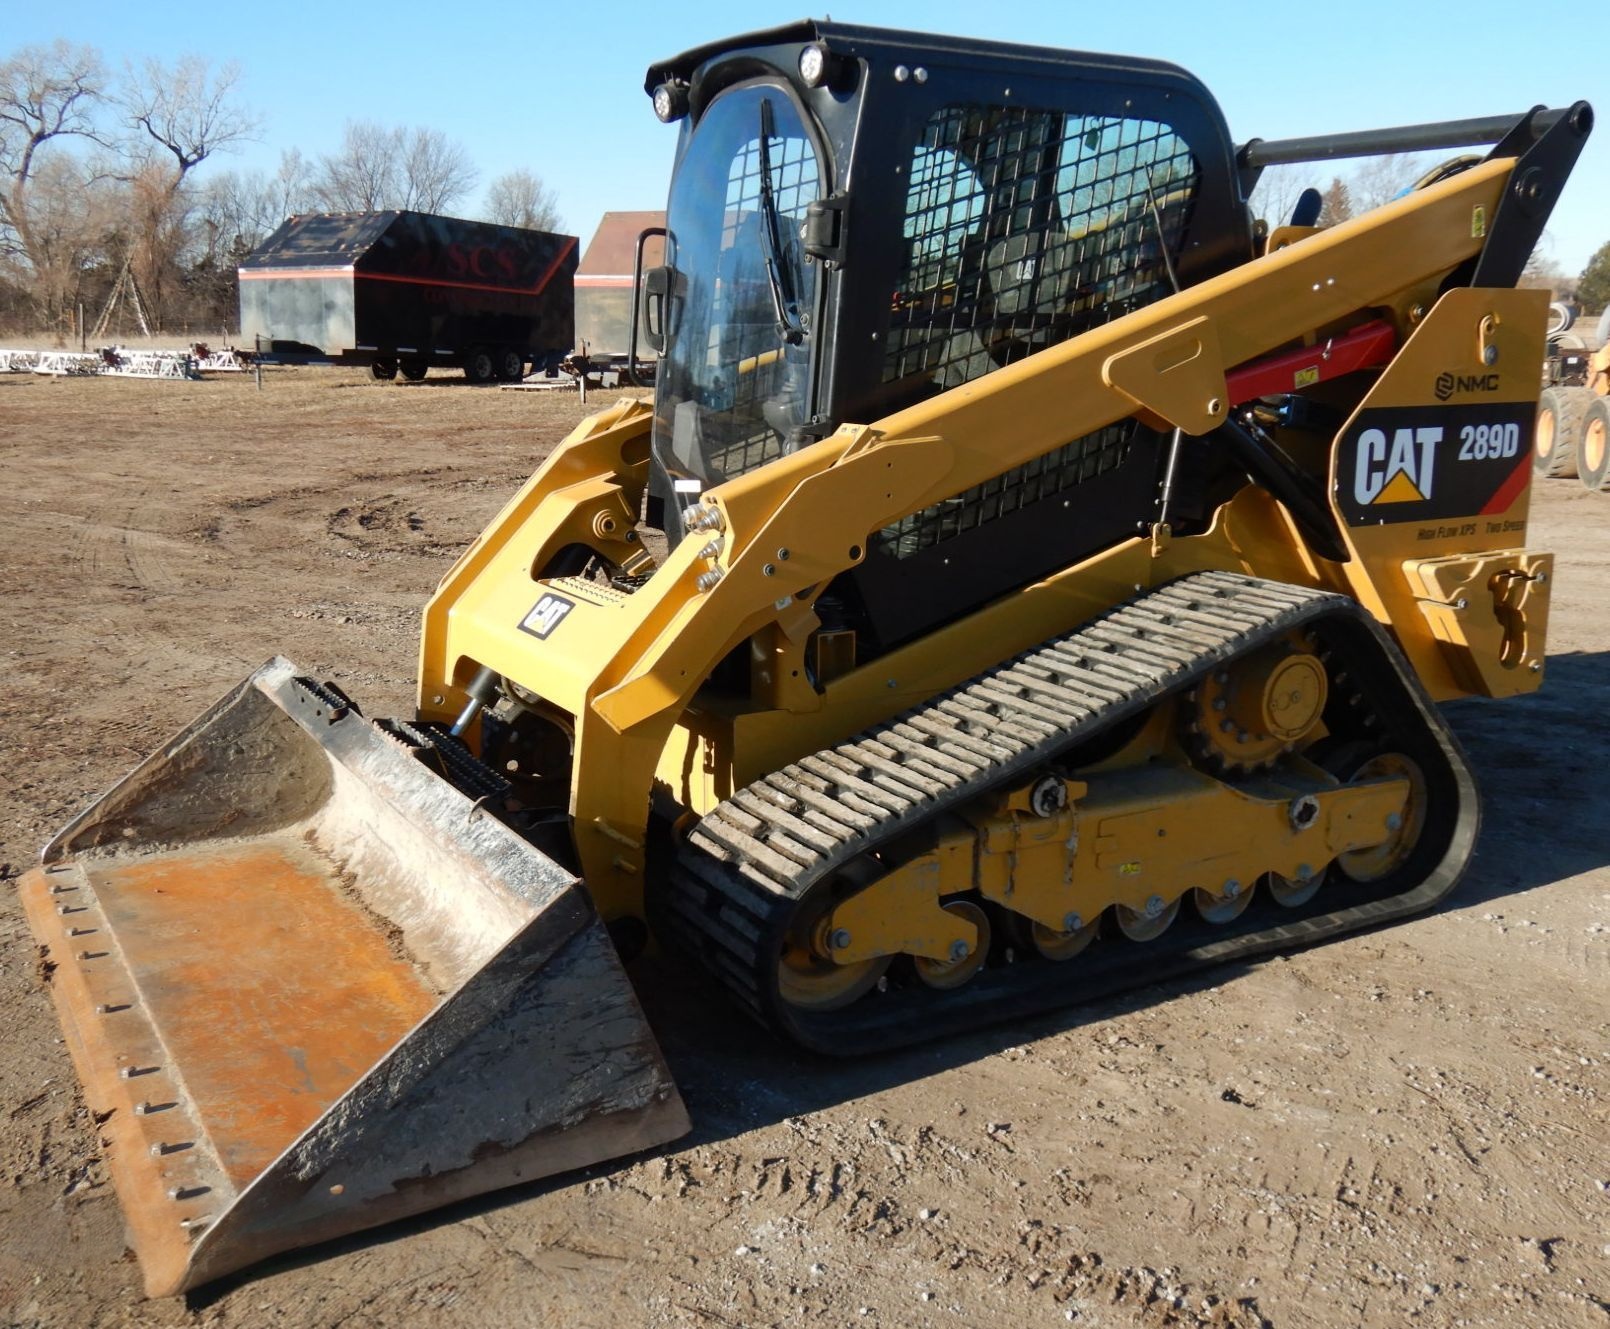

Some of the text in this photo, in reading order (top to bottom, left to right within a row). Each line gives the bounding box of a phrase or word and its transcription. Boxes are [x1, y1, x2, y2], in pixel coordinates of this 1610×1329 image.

[1456, 374, 1499, 392] NMC
[1458, 423, 1519, 461] 289D
[1354, 426, 1443, 505] CAT
[523, 596, 570, 635] CAT
